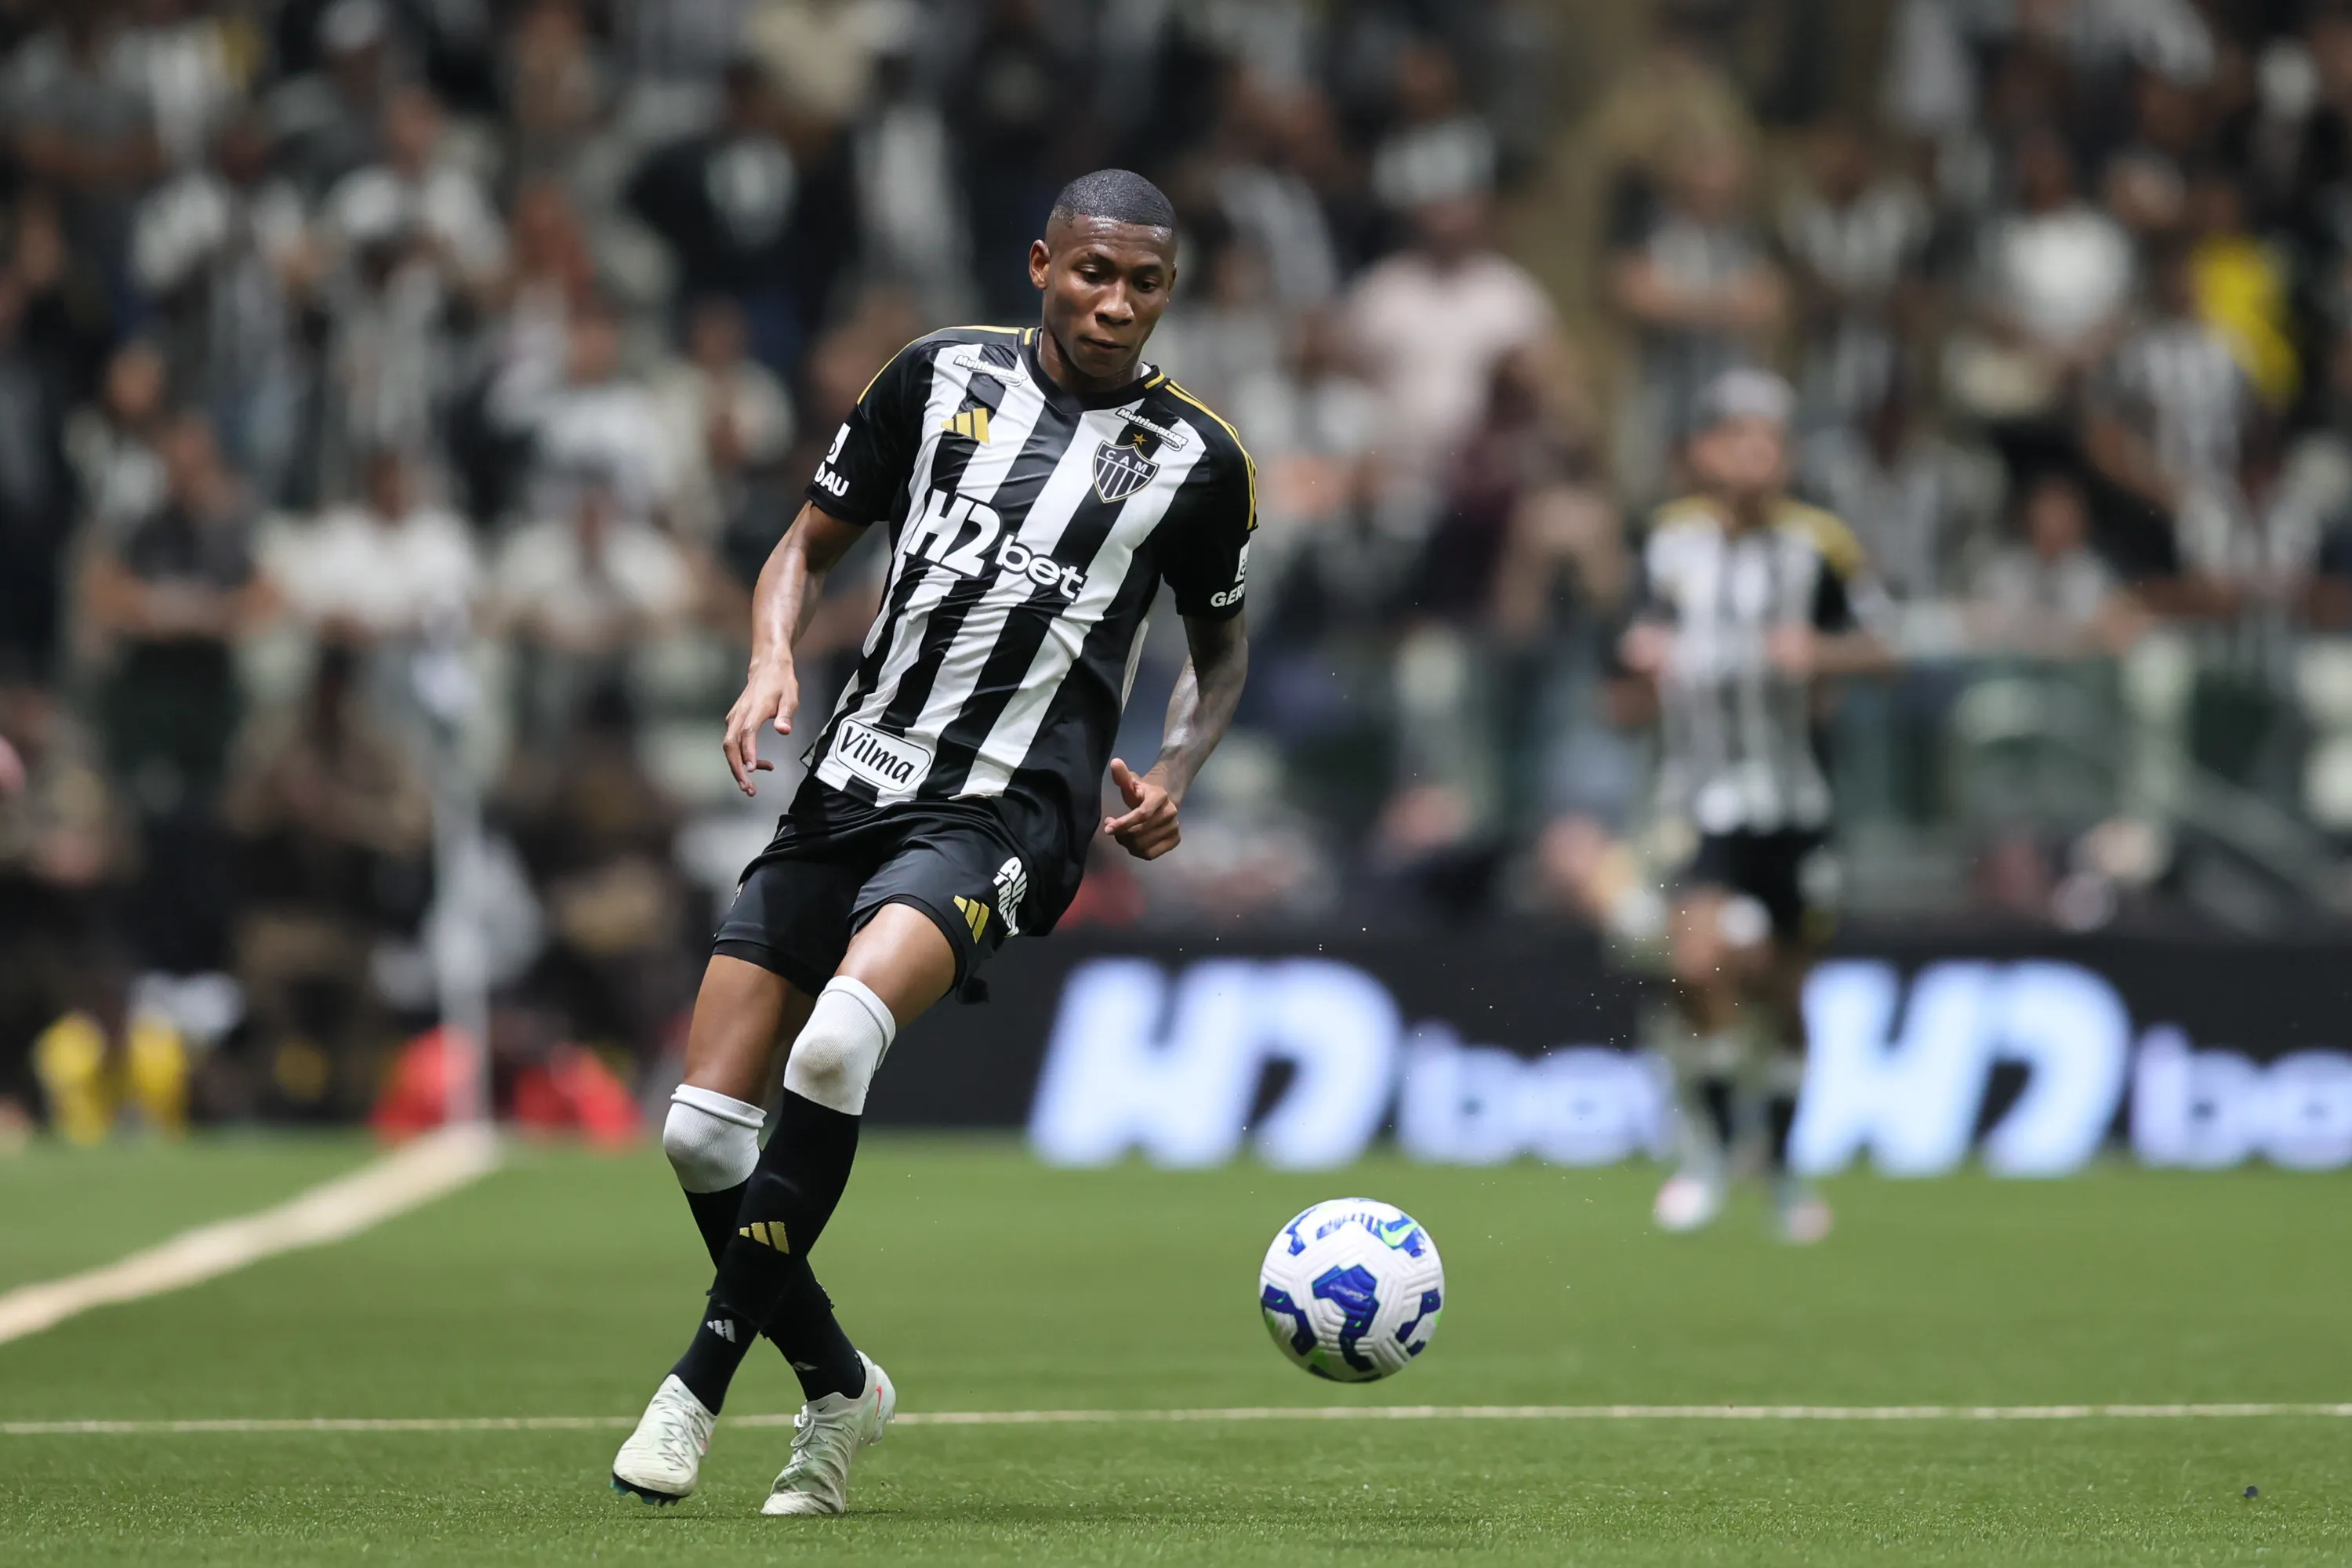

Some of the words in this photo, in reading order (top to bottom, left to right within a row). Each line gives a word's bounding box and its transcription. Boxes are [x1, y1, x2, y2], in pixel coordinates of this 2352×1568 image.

[814, 461, 850, 497] DAU
[1210, 583, 1245, 608] GER
[840, 725, 915, 784] Vilma
[1791, 958, 2352, 1176] H2be
